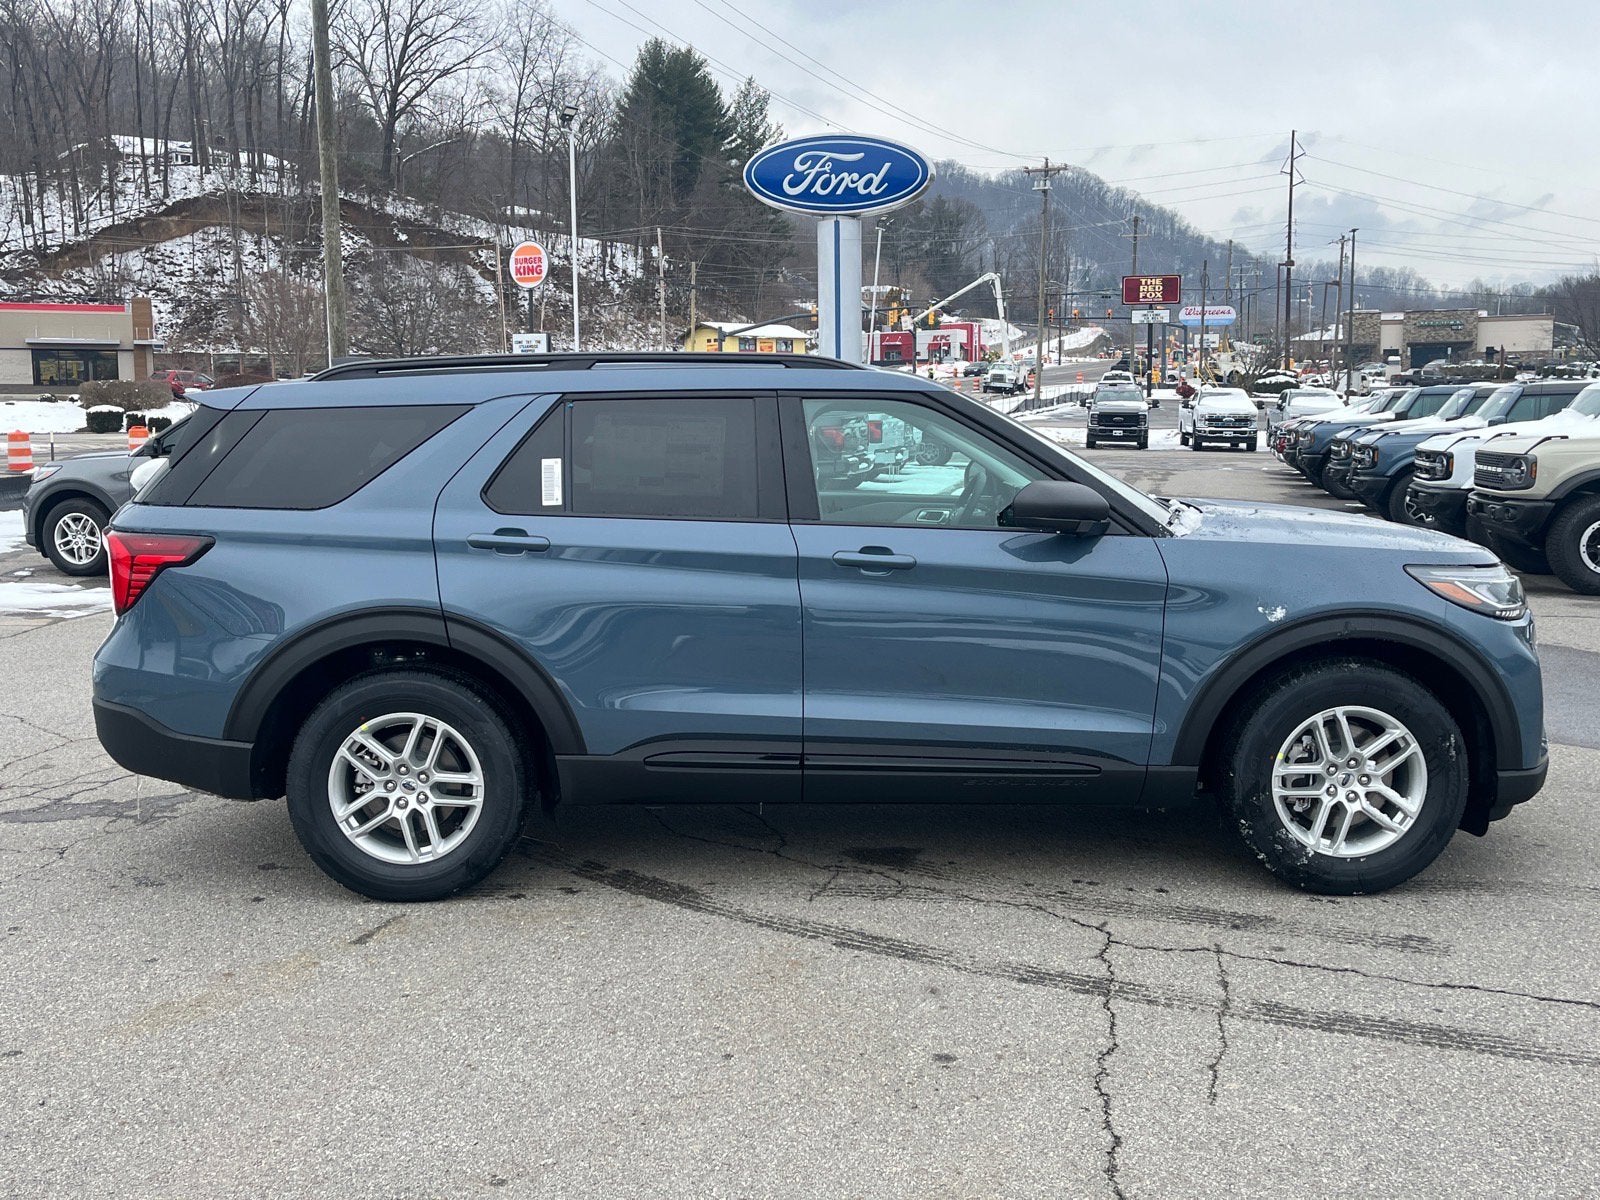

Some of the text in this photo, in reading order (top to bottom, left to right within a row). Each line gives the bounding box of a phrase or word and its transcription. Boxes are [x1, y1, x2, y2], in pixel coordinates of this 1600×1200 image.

[783, 150, 892, 196] Ford
[514, 256, 543, 265] BURGER
[514, 265, 543, 276] KING
[1139, 278, 1163, 286] THE
[1139, 291, 1163, 299] FOX
[932, 334, 951, 342] KFC
